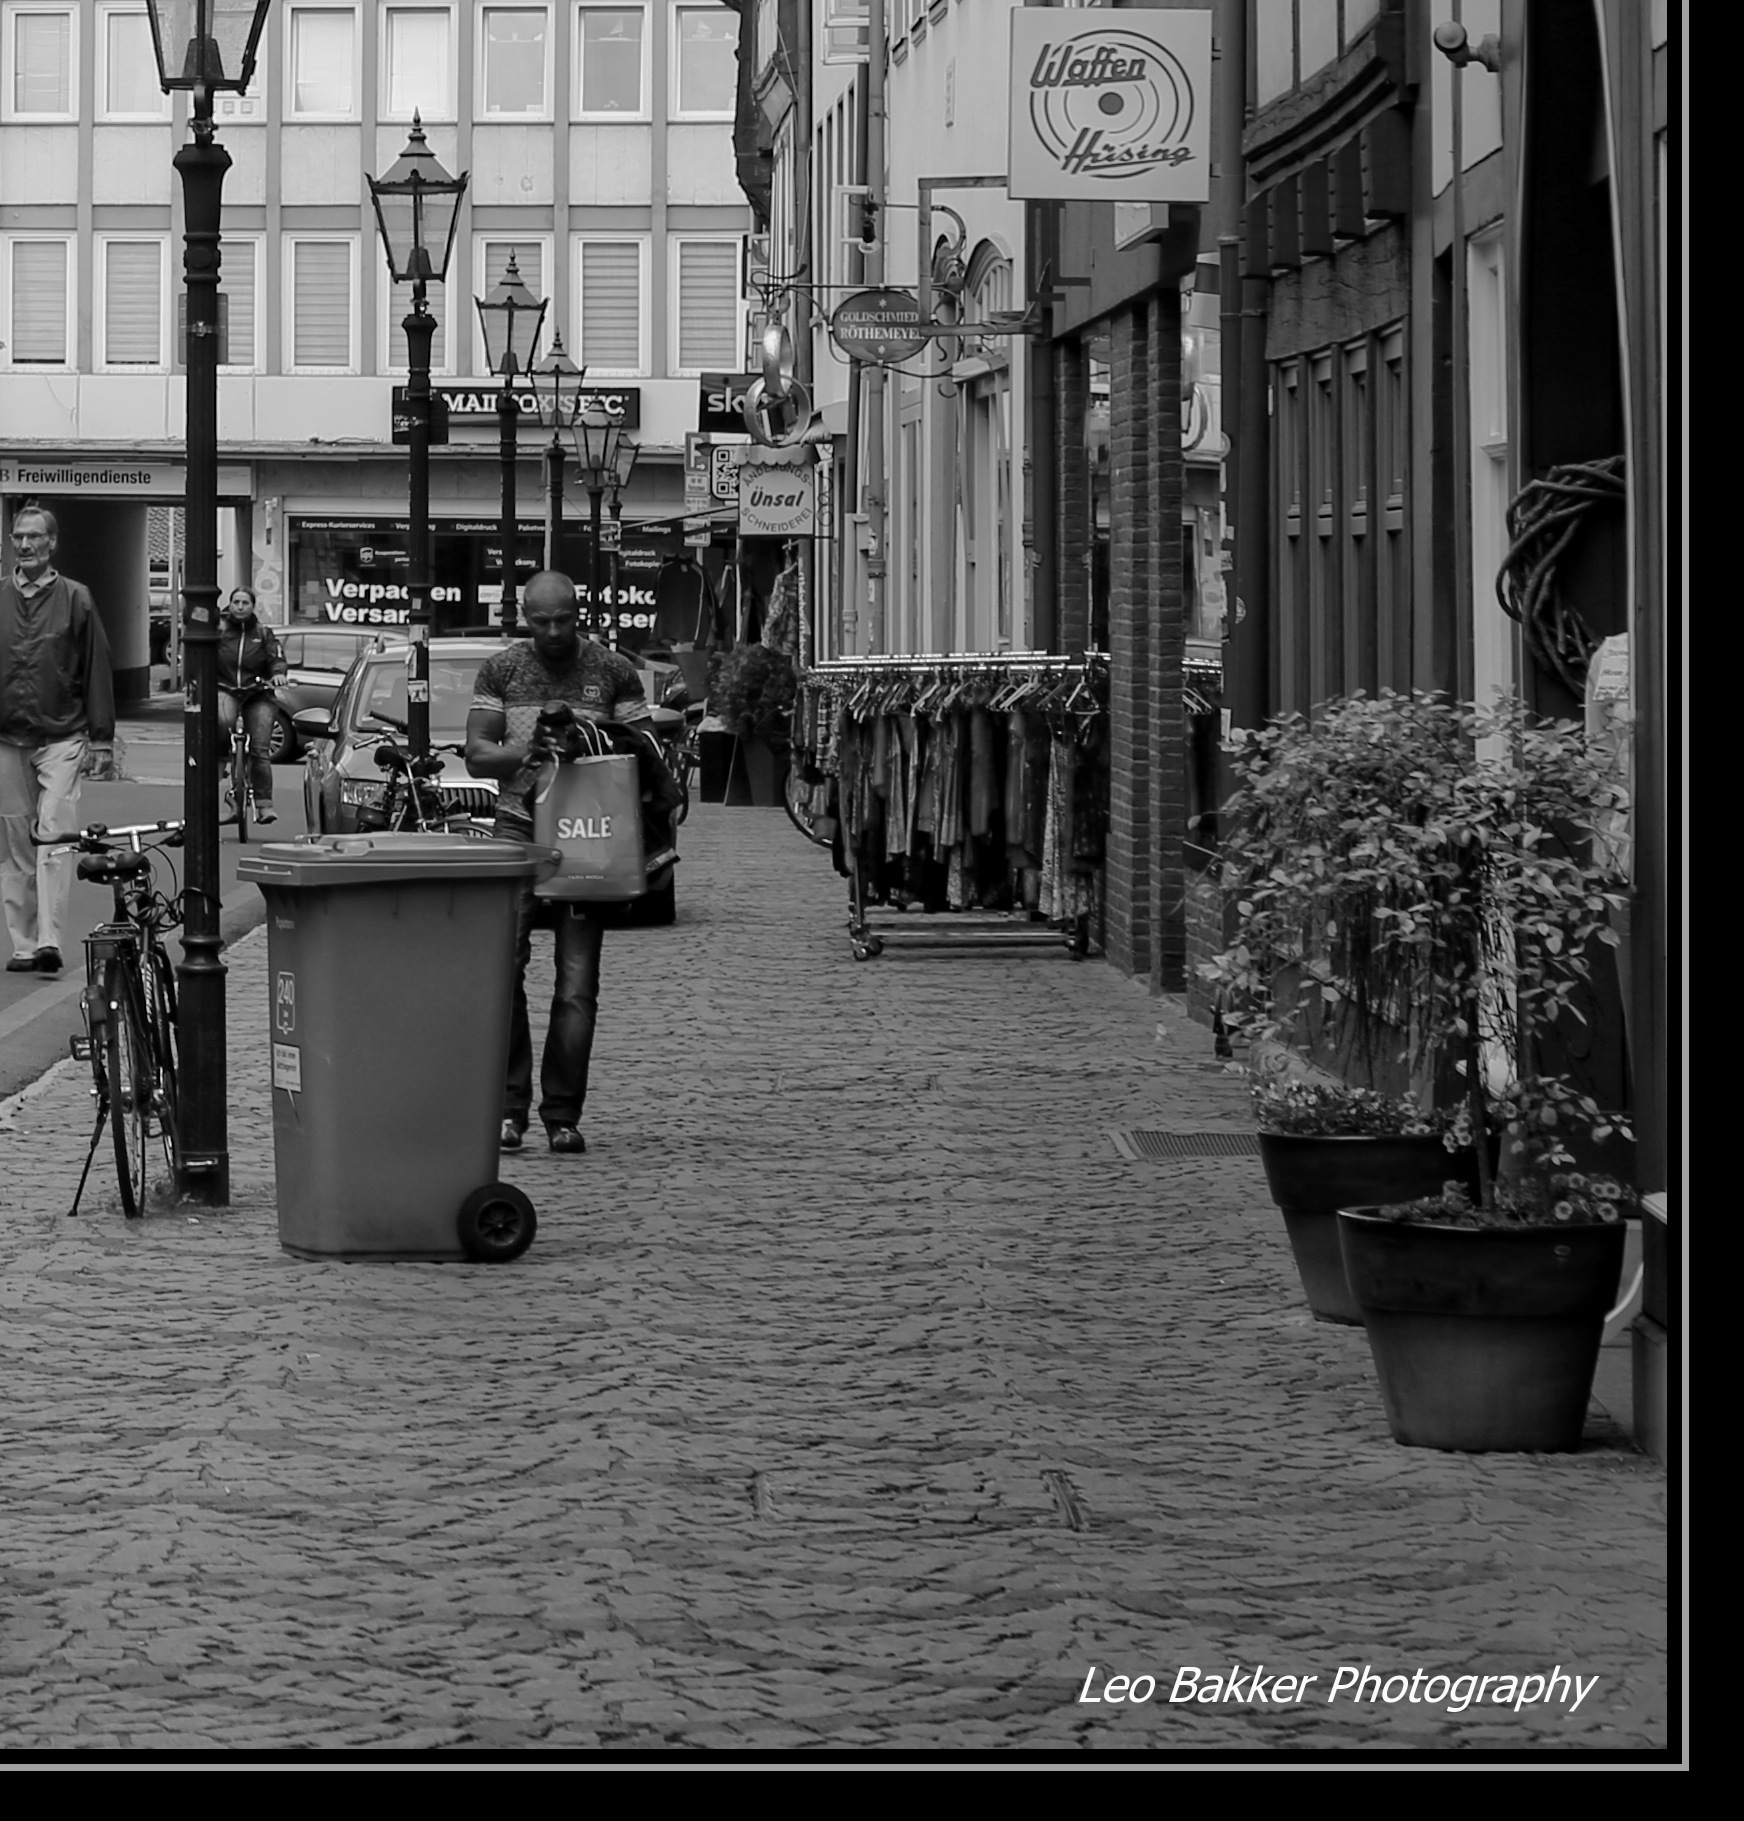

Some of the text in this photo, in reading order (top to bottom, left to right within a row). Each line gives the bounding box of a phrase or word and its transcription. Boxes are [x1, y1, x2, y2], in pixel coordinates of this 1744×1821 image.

[1030, 43, 1146, 88] Waffen
[840, 311, 919, 323] GOLDSCHMIED
[707, 386, 748, 413] sk
[17, 469, 151, 486] Freiwilligendienste
[750, 486, 805, 507] Ünsal
[741, 506, 812, 533] SCHNEIDEREI
[325, 578, 461, 603] Verpacen
[557, 816, 612, 840] SALE
[277, 978, 294, 1006] 240
